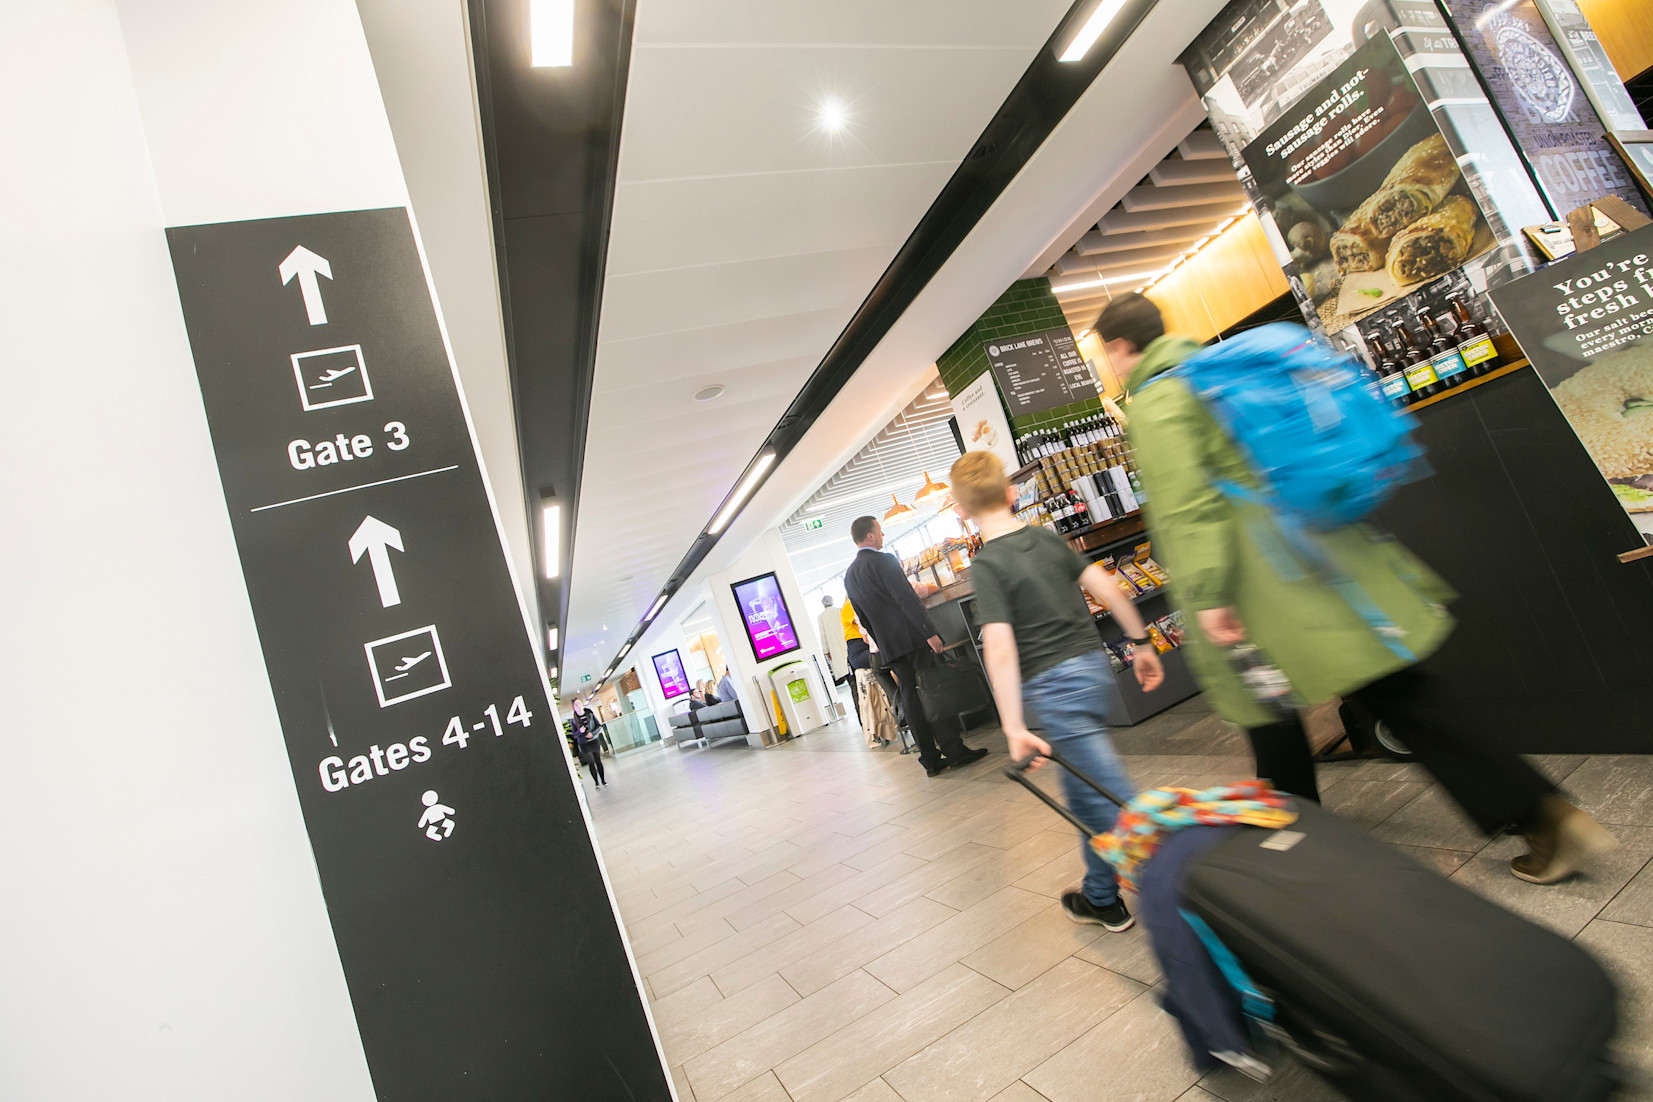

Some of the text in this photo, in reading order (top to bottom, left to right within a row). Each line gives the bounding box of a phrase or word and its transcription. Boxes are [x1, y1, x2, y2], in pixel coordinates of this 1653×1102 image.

[1266, 68, 1369, 156] Sausage and not-
[1280, 90, 1364, 159] sausage rolls.
[1286, 168, 1304, 184] more
[1304, 152, 1325, 170] styles
[1324, 138, 1343, 154] than
[1362, 106, 1384, 124] Even
[1290, 108, 1371, 172] Our sausage rolls have
[1294, 118, 1381, 185] some veggies will adore.
[1539, 150, 1627, 194] COFFEE
[1552, 254, 1649, 296] You're
[1556, 280, 1628, 316] steps
[1564, 294, 1640, 330] fresh
[1000, 338, 1044, 352] BRICK LANE BREWS
[1576, 329, 1600, 342] Our
[1604, 318, 1630, 332] salt
[1580, 332, 1616, 349] every
[1582, 334, 1641, 358] maestro,
[962, 384, 983, 405] Coffee and
[287, 421, 410, 471] Gate 3
[318, 695, 533, 793] Gates 4-14
